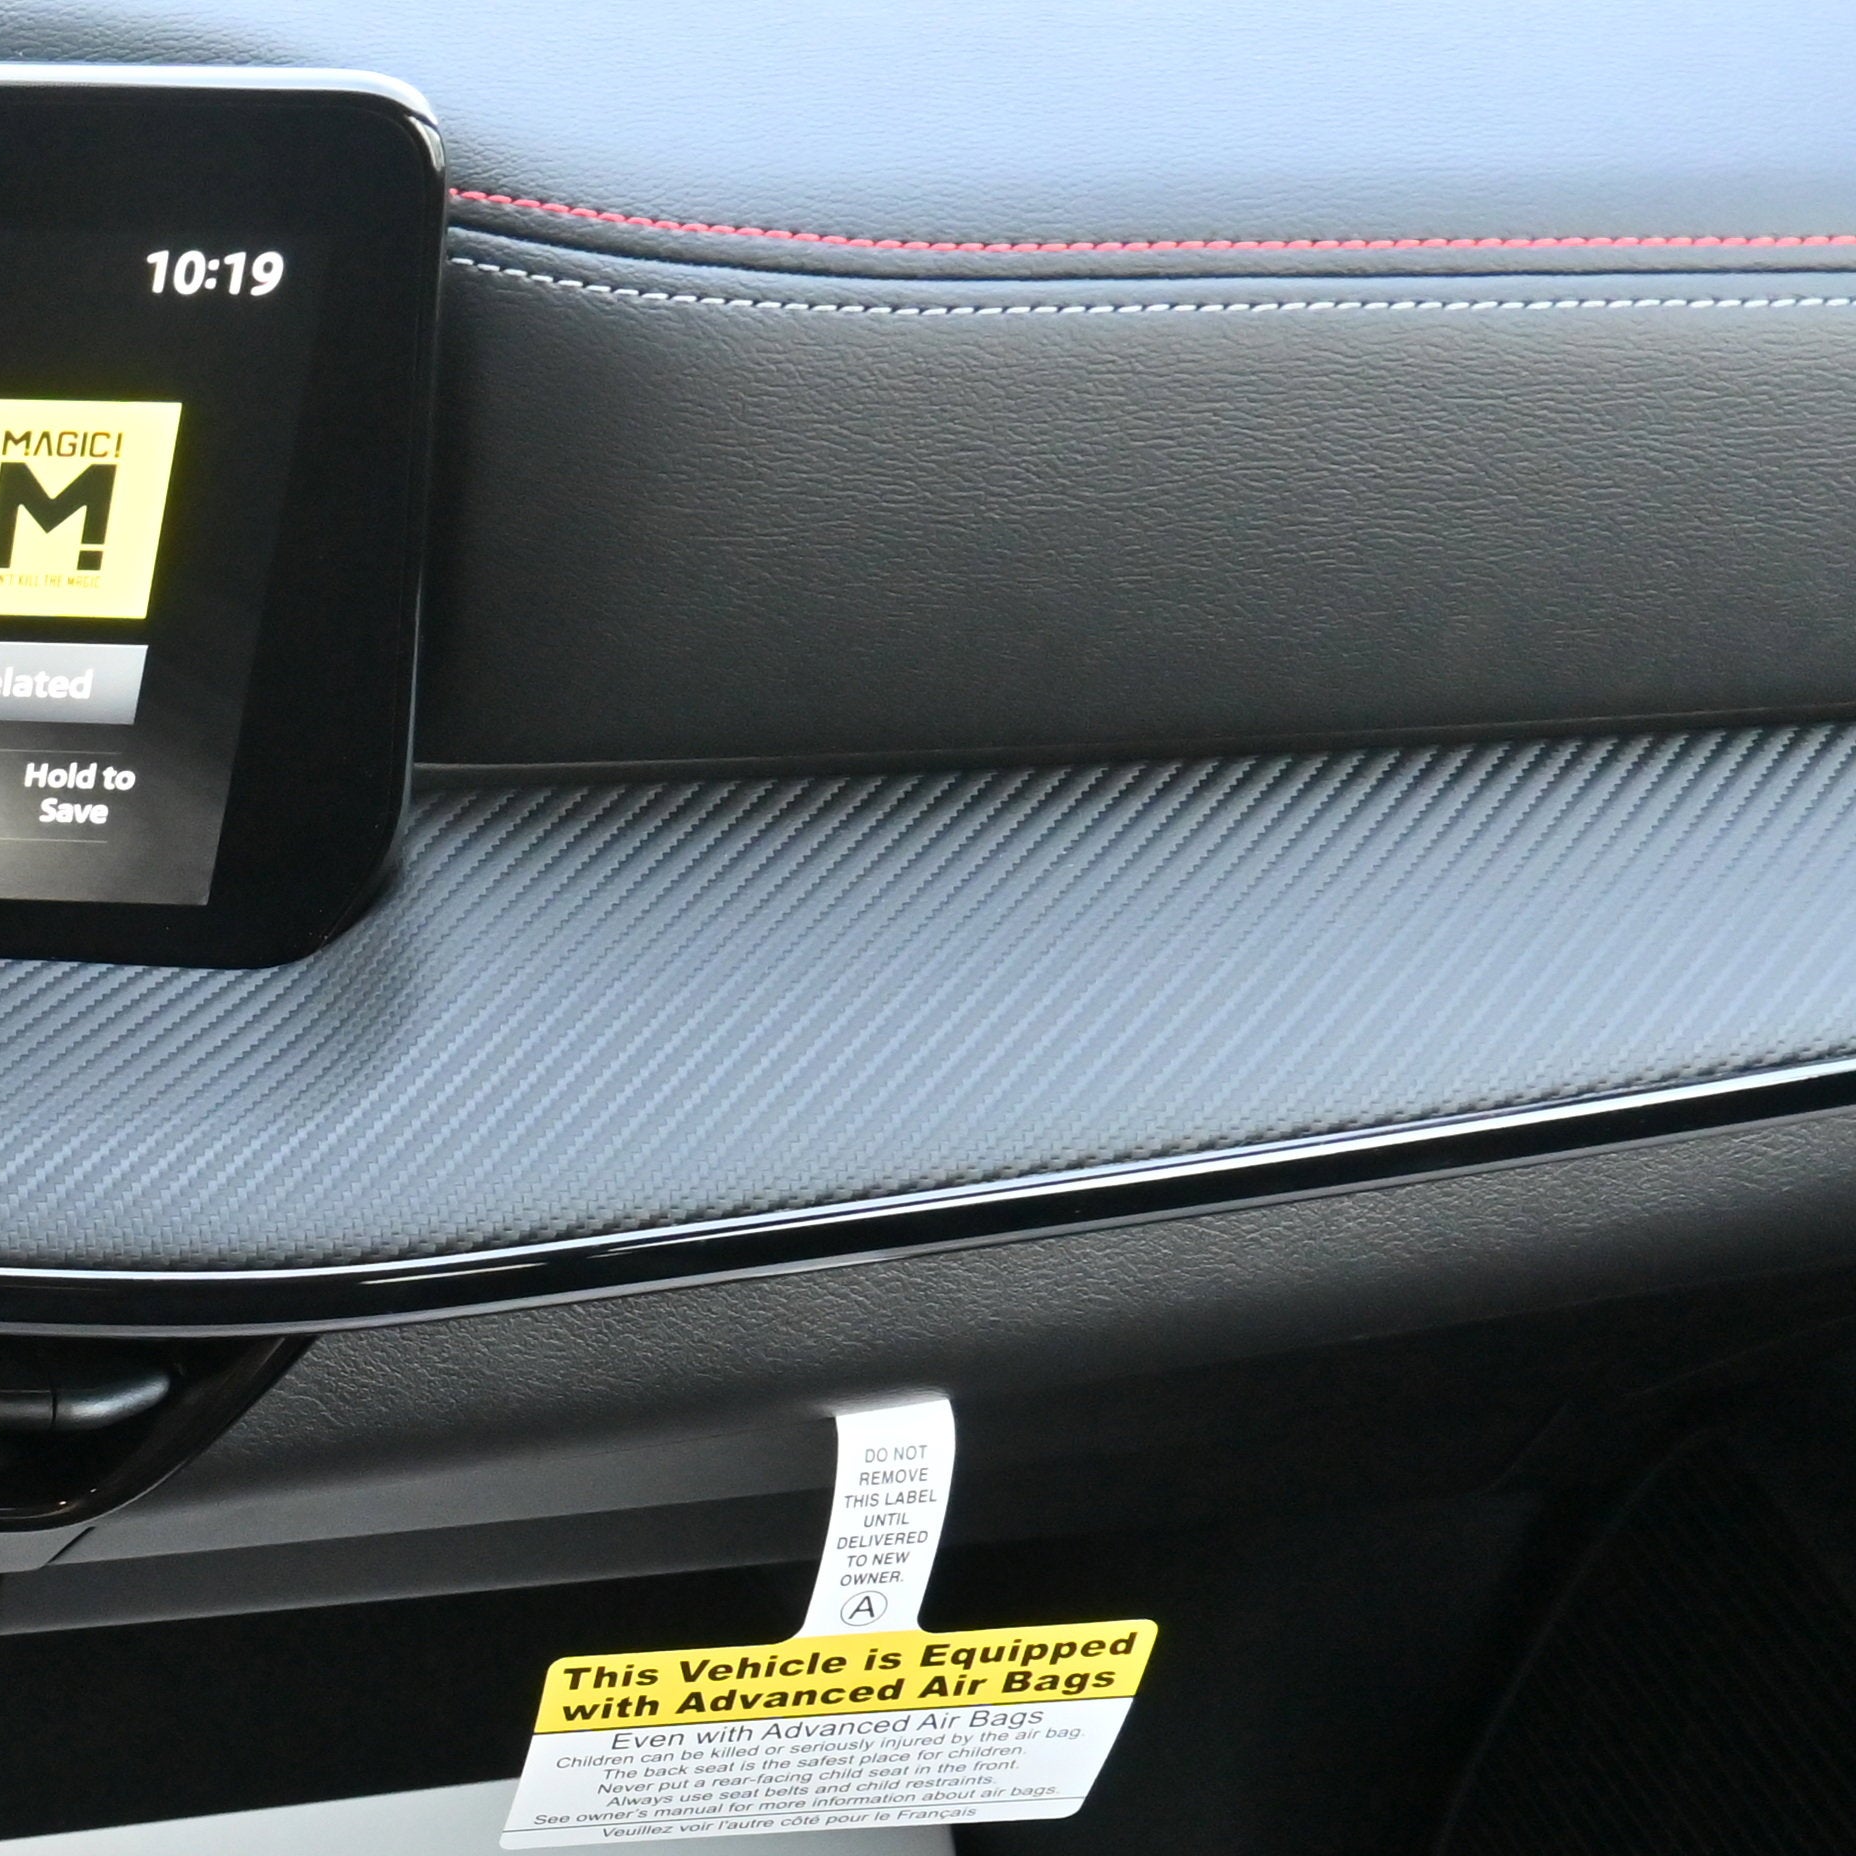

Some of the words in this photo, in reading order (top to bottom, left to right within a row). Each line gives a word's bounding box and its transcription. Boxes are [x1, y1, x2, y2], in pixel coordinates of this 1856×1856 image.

[146, 250, 284, 295] 10:19
[2, 430, 123, 458] MAGIC!
[25, 761, 97, 791] Hold
[103, 766, 135, 791] to
[39, 799, 108, 826] Save
[865, 1446, 889, 1463] DO
[893, 1444, 929, 1461] NOT
[859, 1467, 929, 1486] REMOVE
[844, 1493, 880, 1509] THIS
[885, 1489, 937, 1506] LABEL
[863, 1512, 910, 1528] UNTIL
[837, 1530, 929, 1550] DELIVERED
[847, 1554, 868, 1568] TO
[872, 1551, 911, 1566] NEW
[839, 1570, 904, 1587] OWNER.
[848, 1595, 875, 1620] A
[563, 1665, 659, 1690] This
[679, 1652, 847, 1683] Vehicle
[864, 1648, 902, 1671] is
[920, 1632, 1137, 1670] Equipped
[563, 1695, 659, 1721] with
[676, 1678, 906, 1714] Advanced
[919, 1674, 987, 1699] Air
[1001, 1670, 1116, 1695] Bags
[611, 1732, 684, 1750] Even
[697, 1725, 753, 1745] with
[761, 1715, 911, 1741] Advanced
[917, 1713, 960, 1731] Air
[969, 1710, 1044, 1731] Bags
[556, 1753, 634, 1769] Children
[640, 1752, 675, 1764] can
[681, 1748, 704, 1761] be
[710, 1745, 760, 1759] killed
[765, 1745, 784, 1755] or
[789, 1739, 875, 1754] seriously
[880, 1734, 945, 1750] injured
[950, 1730, 974, 1746] by
[979, 1730, 1009, 1742] the
[1014, 1728, 1041, 1740] air
[1045, 1726, 1086, 1741] bag.
[604, 1767, 637, 1780] The
[643, 1765, 687, 1778] back
[694, 1762, 734, 1774] seat
[739, 1760, 755, 1772] is
[762, 1758, 790, 1770] the
[796, 1754, 854, 1768] safest
[859, 1752, 910, 1767] place
[917, 1748, 944, 1761] for
[948, 1744, 1026, 1760] children.
[597, 1781, 652, 1795] Never
[658, 1779, 689, 1793] put
[694, 1779, 705, 1789] a
[712, 1771, 812, 1787] rear-facing
[818, 1767, 862, 1781] child
[869, 1765, 909, 1778] seat
[915, 1764, 931, 1774] in
[937, 1761, 967, 1773] the
[972, 1759, 1020, 1771] front.
[606, 1793, 674, 1808] Always
[680, 1792, 713, 1803] use
[722, 1787, 760, 1799] seat
[765, 1785, 809, 1797] belts
[815, 1782, 851, 1794] and
[856, 1779, 900, 1792] child
[905, 1775, 996, 1789] restraints.
[534, 1814, 570, 1825] See
[576, 1809, 648, 1823] owner's
[654, 1804, 722, 1818] manual
[728, 1801, 754, 1813] for
[759, 1799, 807, 1810] more
[812, 1792, 916, 1807] information
[922, 1788, 975, 1801] about
[980, 1787, 1005, 1798] air
[1010, 1784, 1060, 1798] bags.
[603, 1824, 673, 1838] Veuillez
[679, 1822, 713, 1833] voir
[718, 1817, 774, 1831] l'autre
[780, 1814, 820, 1827] côté
[825, 1813, 869, 1827] pour
[874, 1810, 891, 1822] le
[896, 1807, 978, 1823] Français
